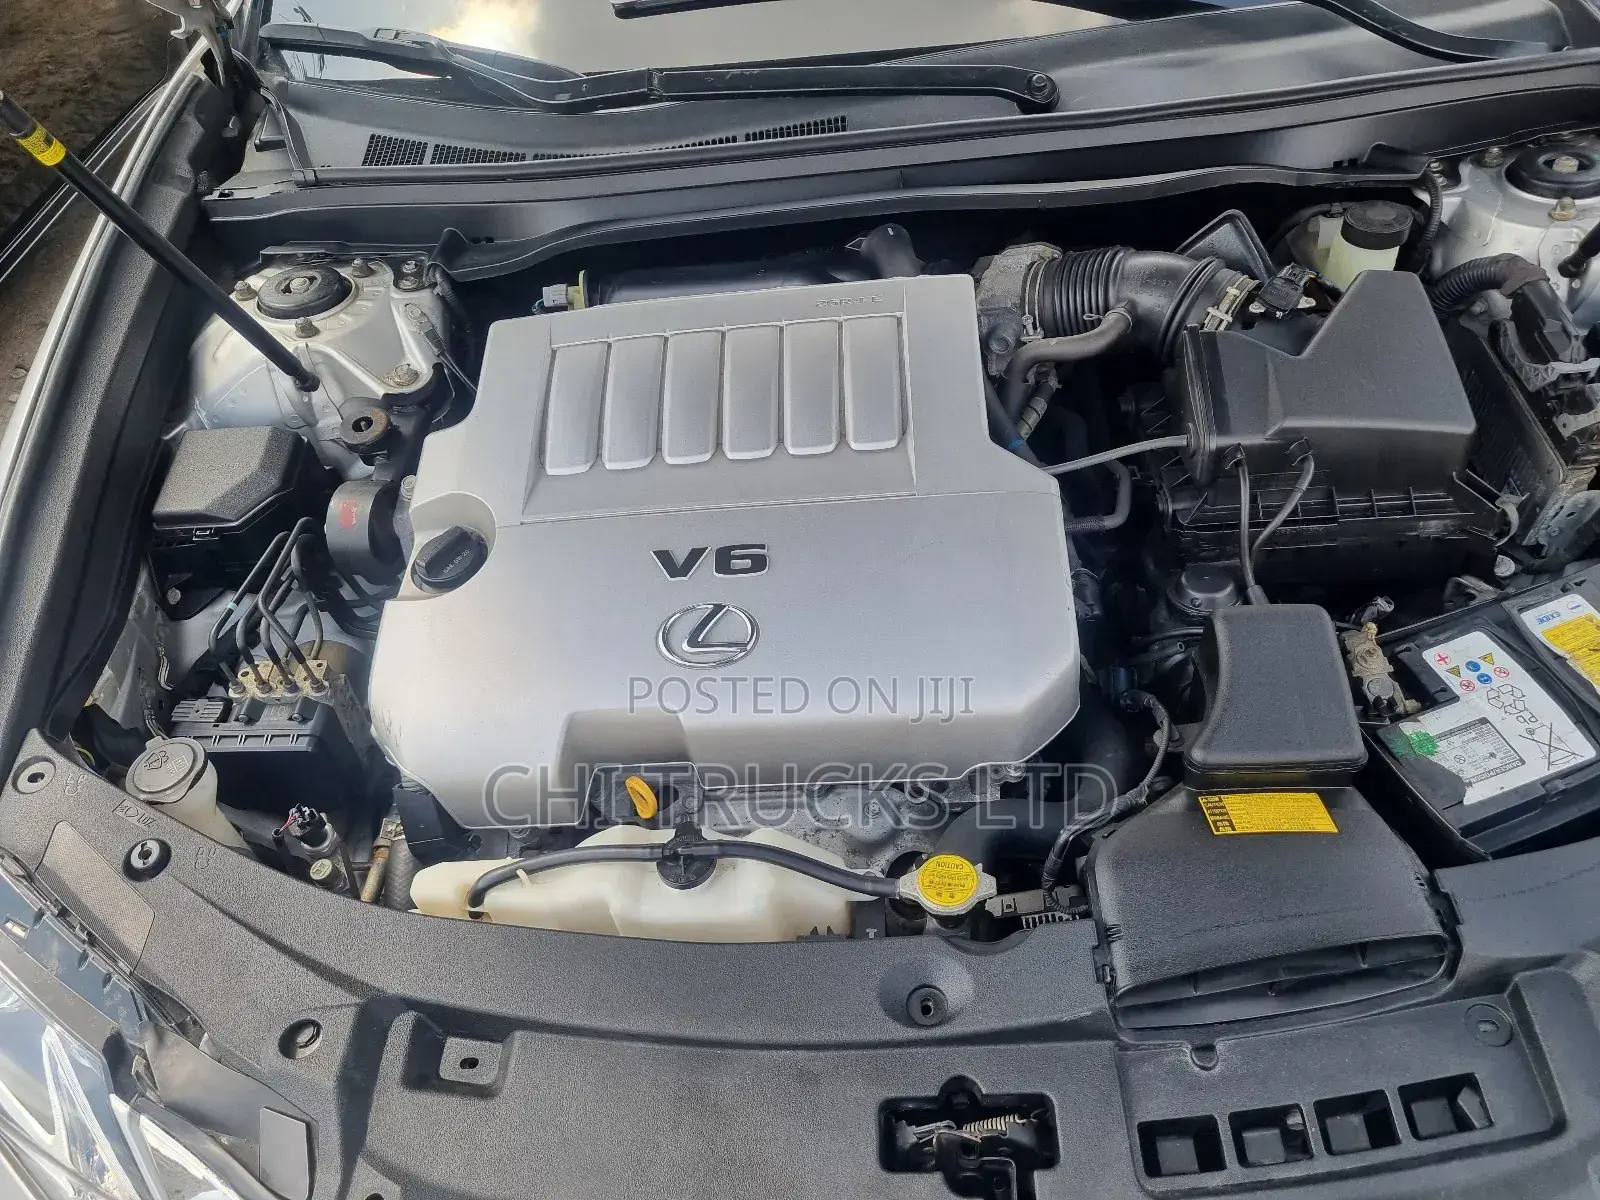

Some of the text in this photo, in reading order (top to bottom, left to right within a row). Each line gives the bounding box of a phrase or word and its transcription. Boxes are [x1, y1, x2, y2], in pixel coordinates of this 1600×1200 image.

[650, 543, 769, 581] V6
[1536, 610, 1561, 625] EXIDE
[1516, 710, 1539, 725] Pb
[935, 860, 964, 870] CAUTION
